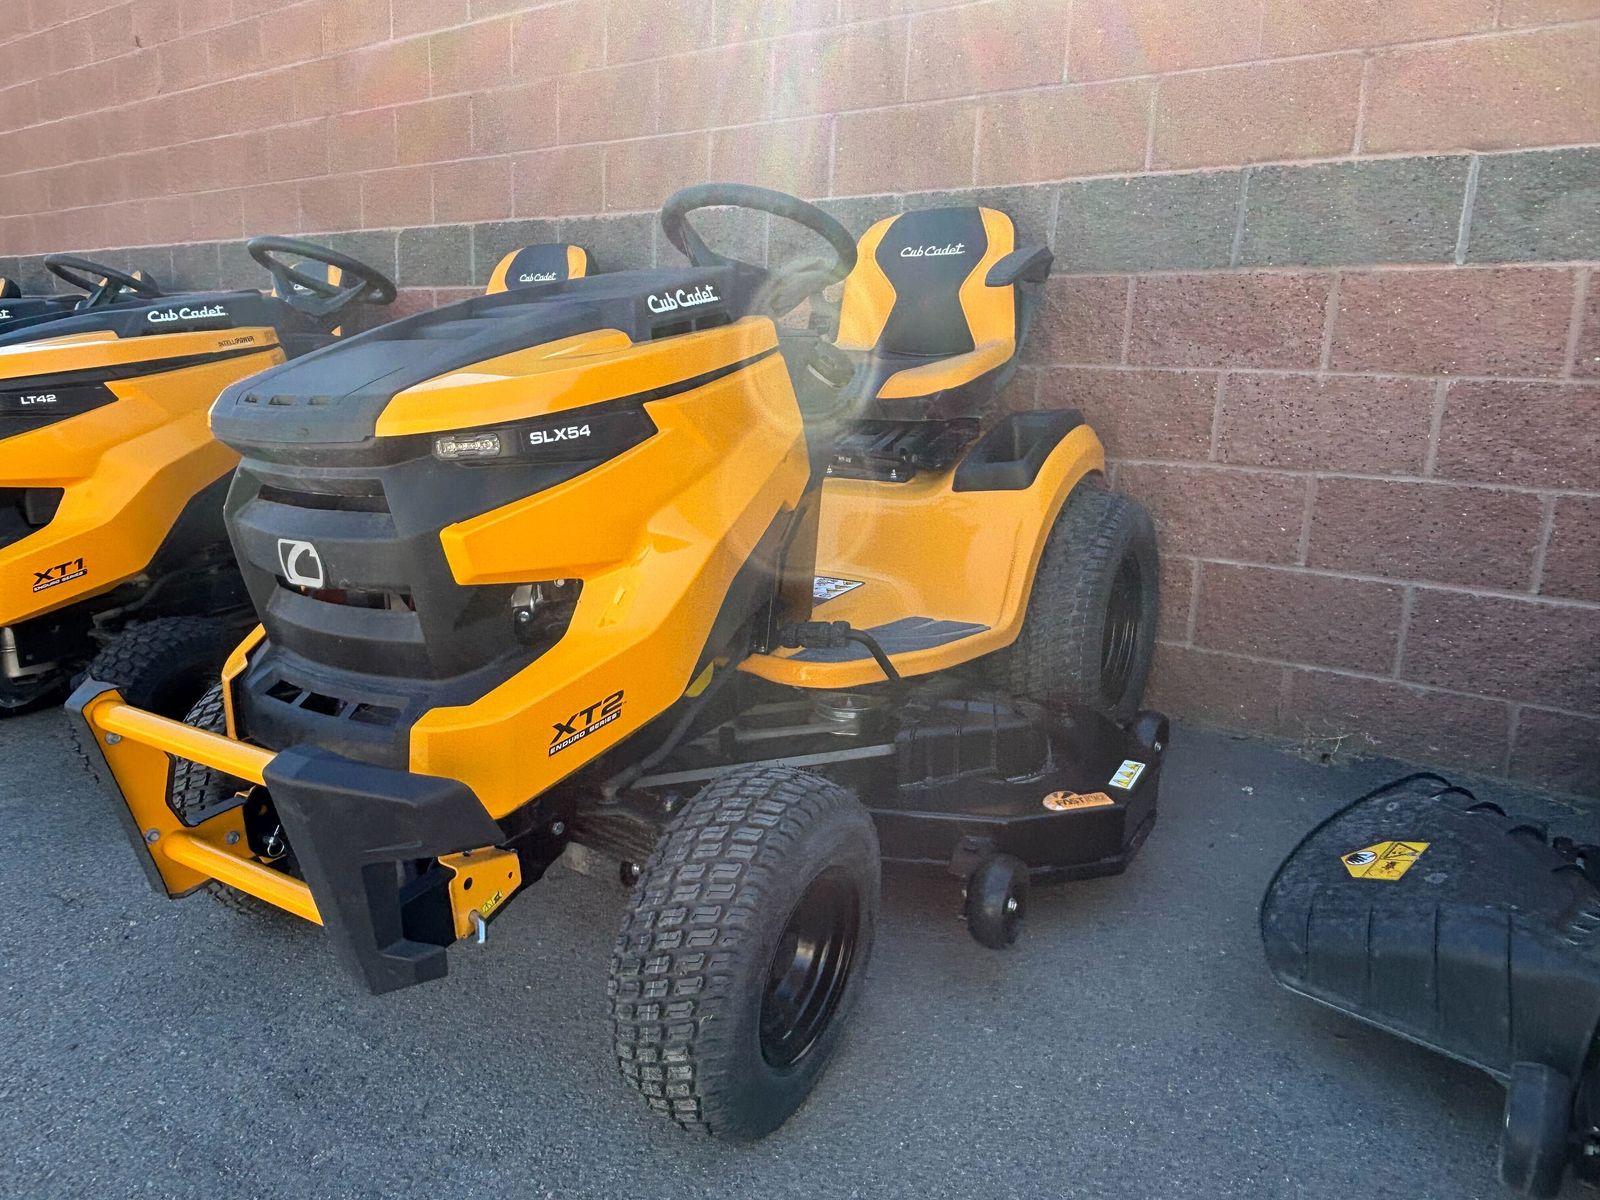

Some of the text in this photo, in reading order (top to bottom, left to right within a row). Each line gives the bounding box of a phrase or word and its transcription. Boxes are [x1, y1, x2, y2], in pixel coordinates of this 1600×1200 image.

[900, 243, 965, 257] Cub Cadet
[519, 272, 557, 282] Cub Cadet
[647, 284, 719, 313] Cub Cadet
[147, 305, 226, 322] Cub Cadet
[20, 394, 57, 405] LT42
[529, 424, 591, 445] SLX54
[33, 557, 84, 586] XT1
[549, 689, 625, 746] XT2
[550, 711, 619, 755] ENDURO SERIES
